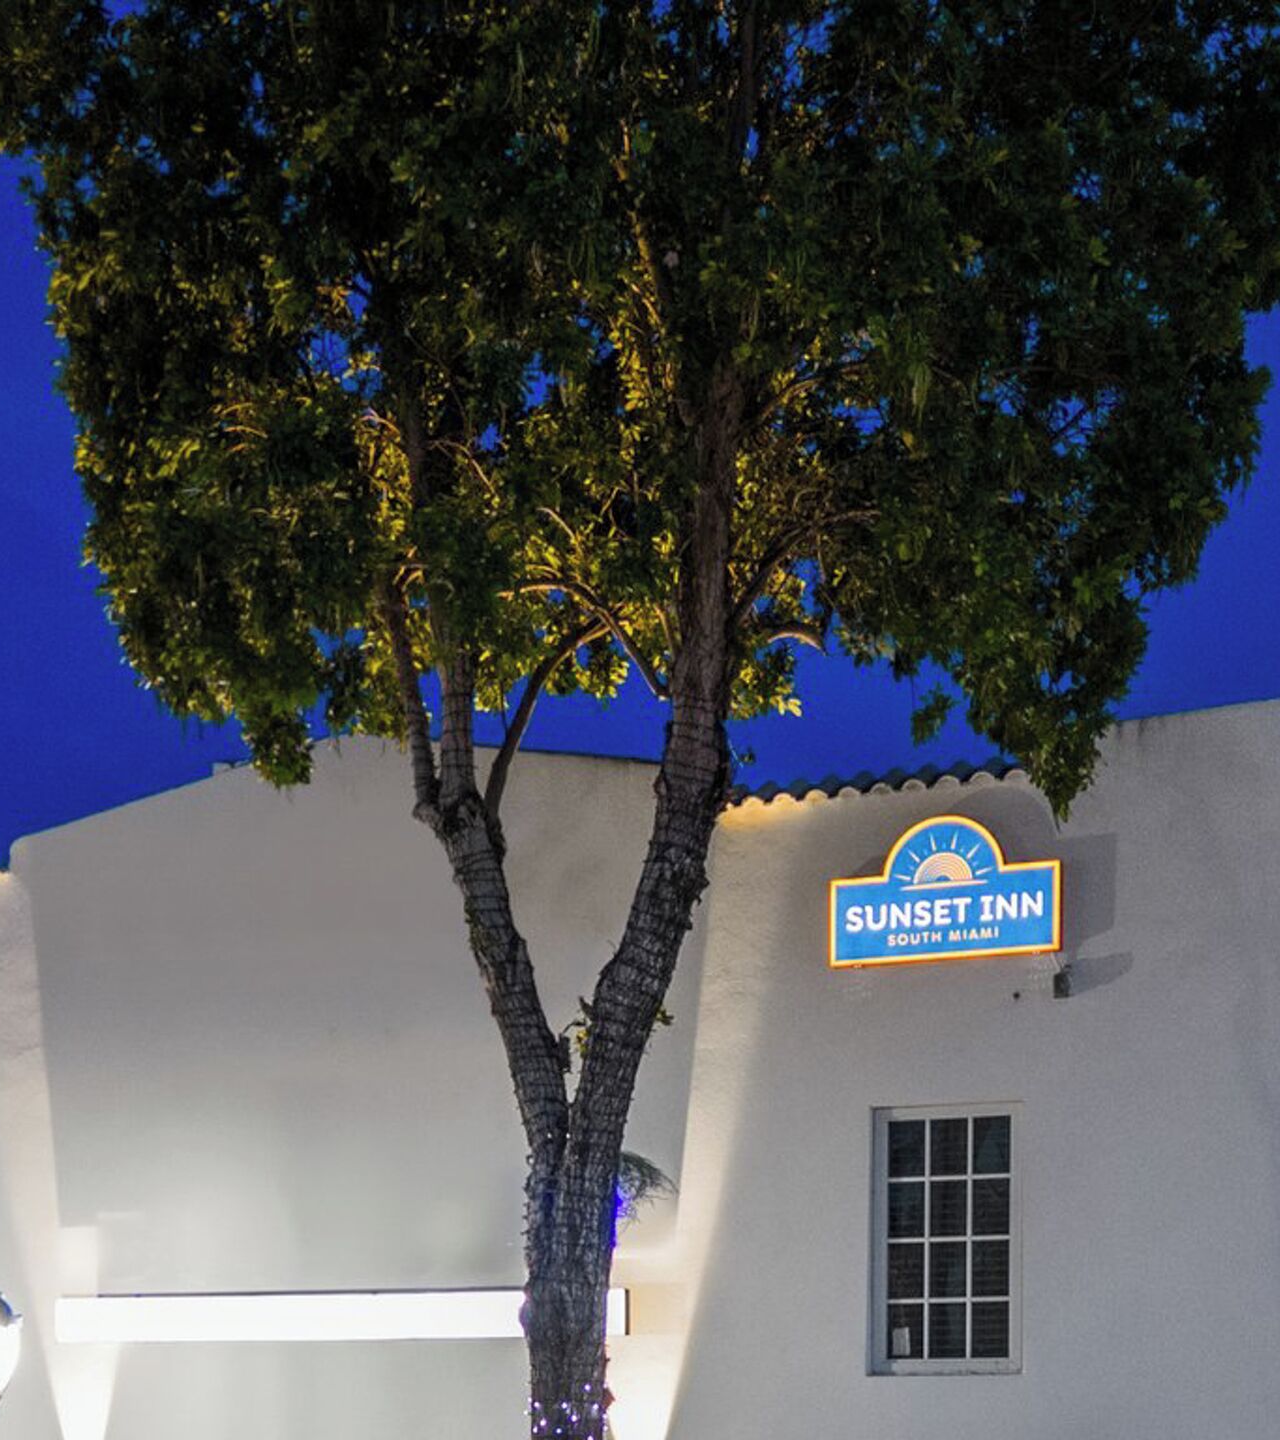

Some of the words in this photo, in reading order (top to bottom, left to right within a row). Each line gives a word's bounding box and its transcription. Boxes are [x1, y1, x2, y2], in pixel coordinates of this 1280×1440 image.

[845, 896, 973, 933] SUNSET
[980, 890, 1044, 922] INN
[887, 931, 942, 947] SOUTH
[948, 926, 999, 942] MIAMI
